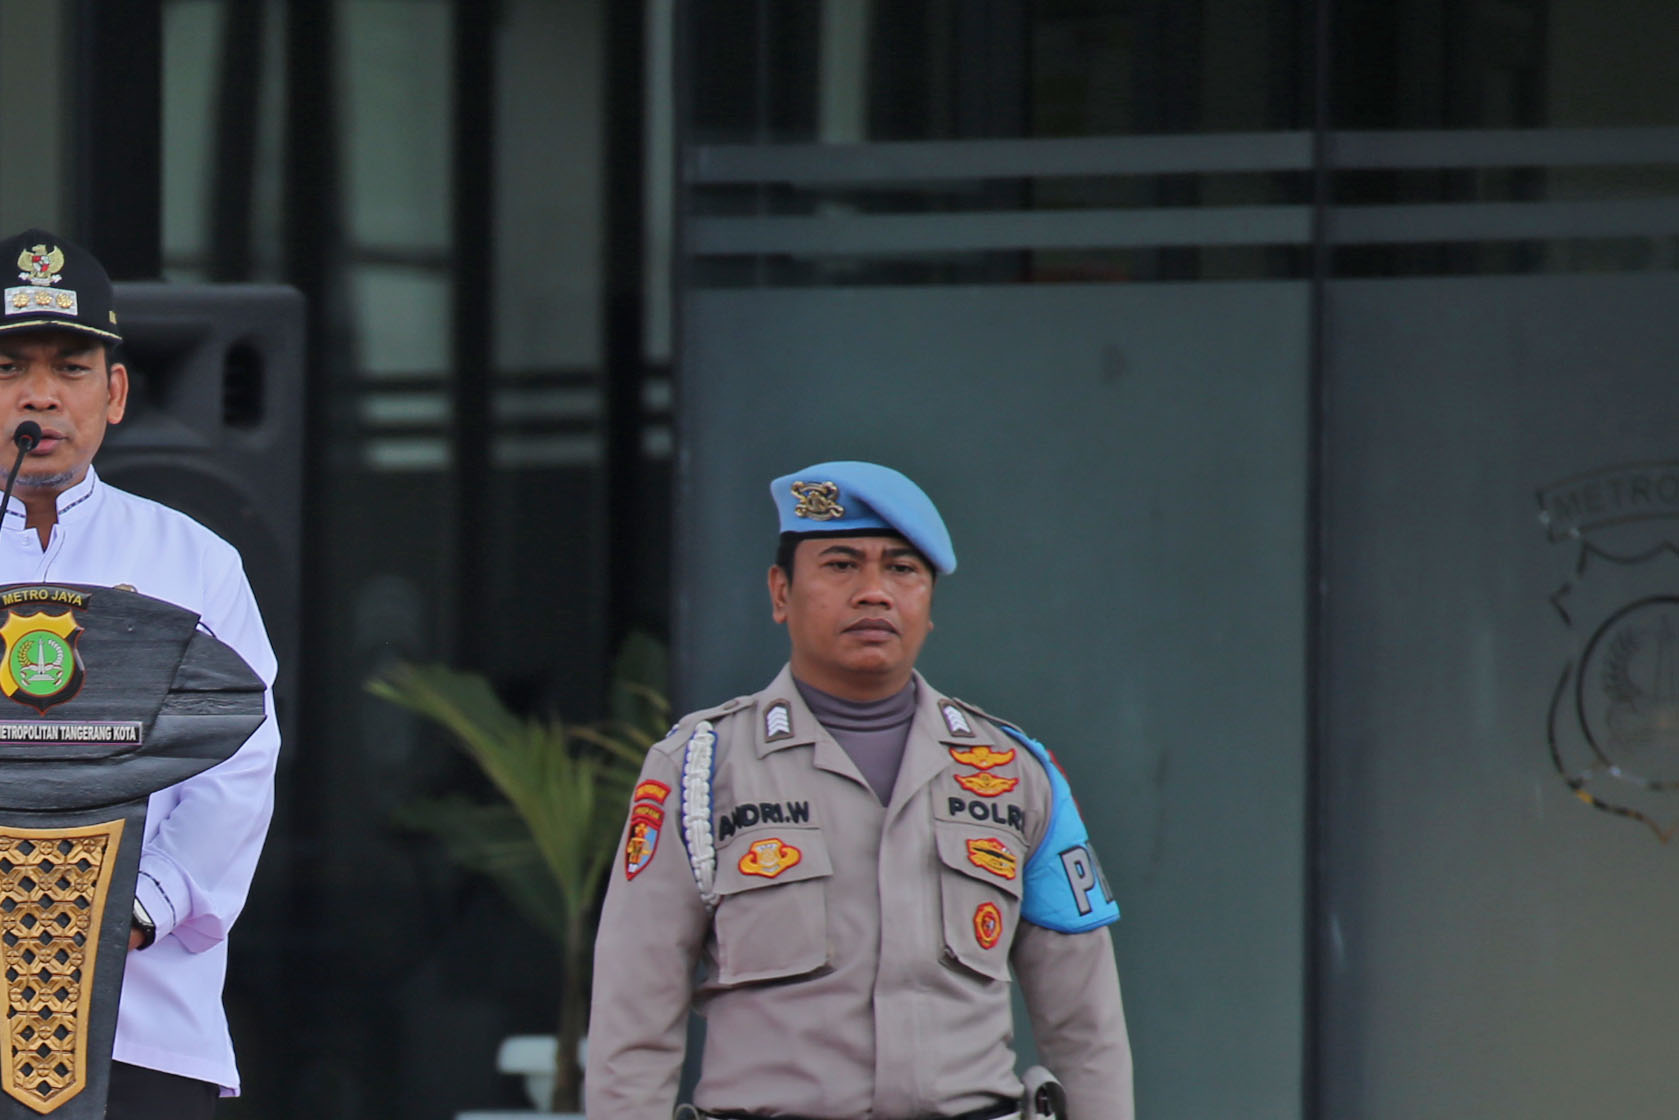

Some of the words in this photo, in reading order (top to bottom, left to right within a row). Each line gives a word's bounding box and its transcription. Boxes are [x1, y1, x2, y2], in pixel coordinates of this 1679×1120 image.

[1553, 473, 1678, 520] METRO
[2, 589, 48, 606] METRO
[51, 590, 82, 606] JAYA
[59, 726, 112, 741] TANGERANG
[113, 727, 136, 741] KOTA
[718, 801, 809, 841] ANDRI.W
